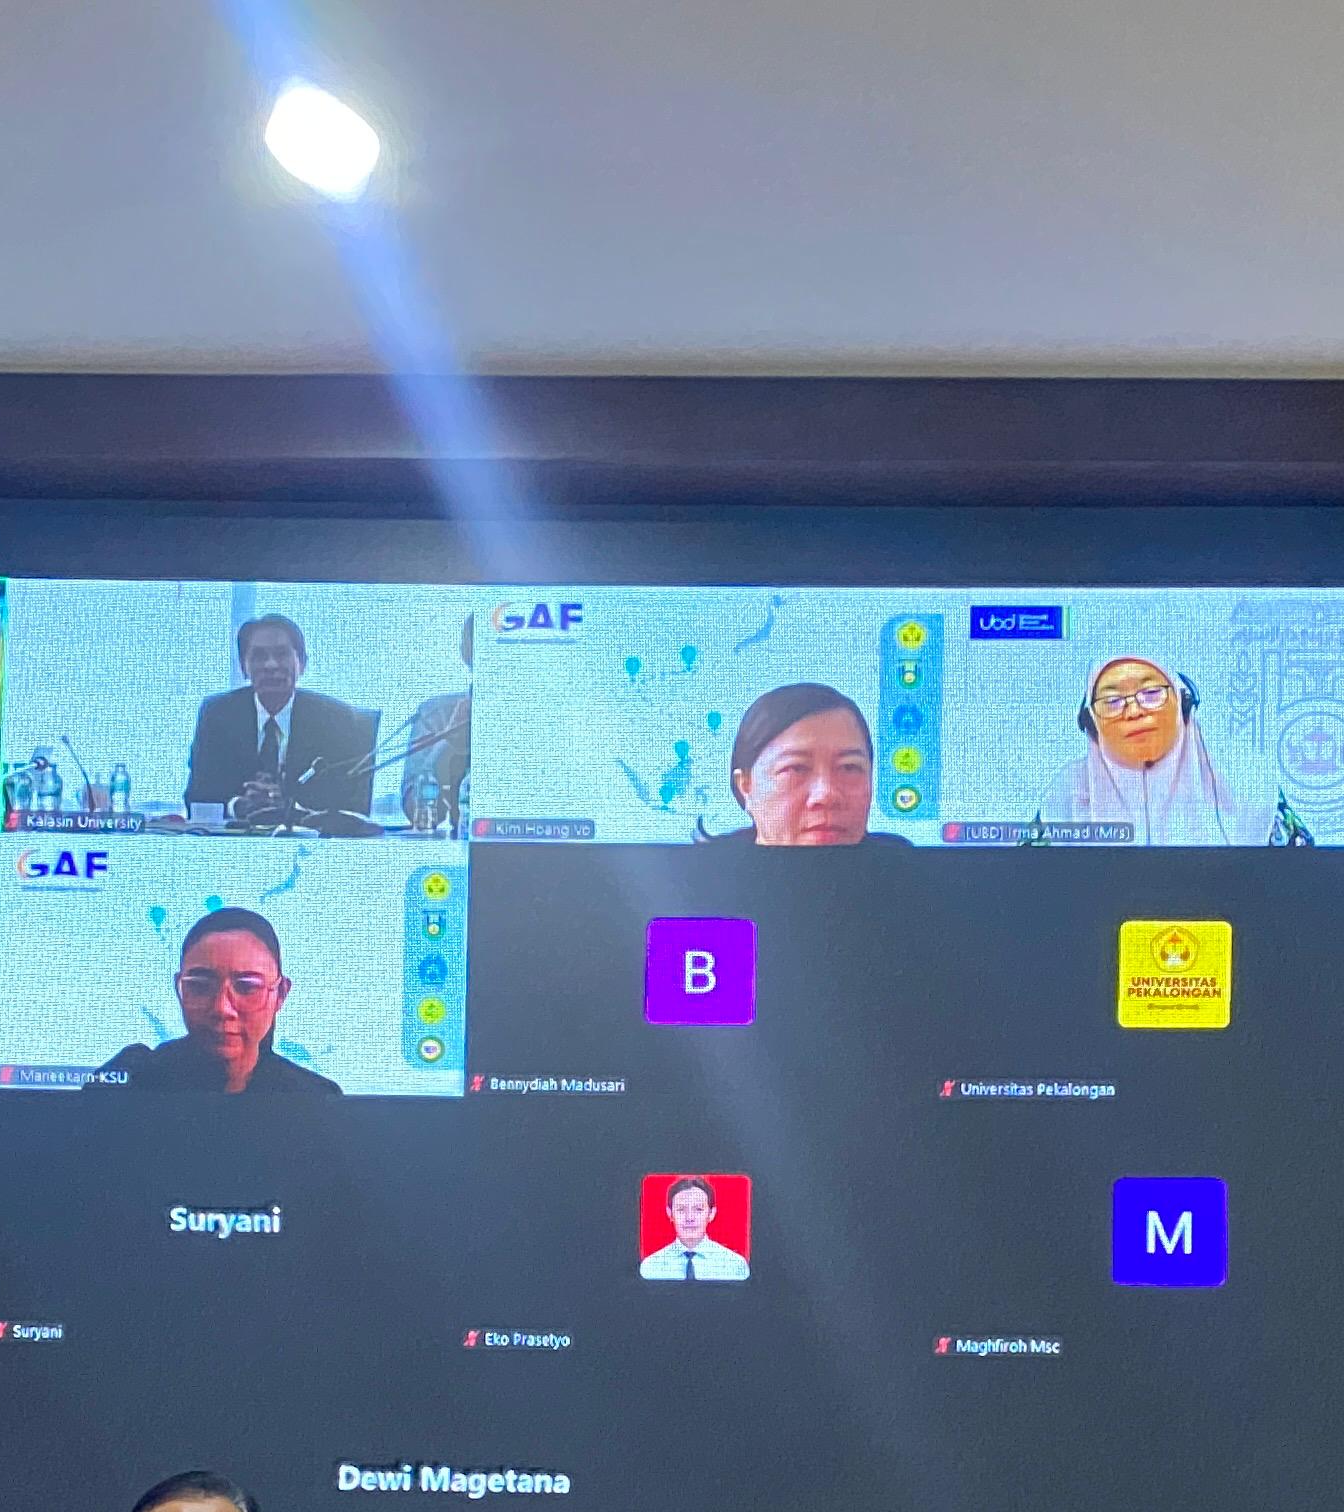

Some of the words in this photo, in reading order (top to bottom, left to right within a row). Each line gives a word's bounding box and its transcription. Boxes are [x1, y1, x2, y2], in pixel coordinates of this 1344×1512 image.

[26, 814, 73, 828] Kalasin
[77, 815, 142, 831] University
[494, 823, 521, 835] Kim
[1042, 826, 1089, 840] Ahmad
[1094, 826, 1130, 841] (Mrs)
[17, 849, 109, 880] GAF
[684, 950, 717, 995] B
[1131, 976, 1217, 987] UNIVERSITAS
[1127, 987, 1222, 998] PEKALONGAN
[490, 1078, 557, 1094] Bennydiah
[561, 1078, 626, 1092] Madusari
[960, 1082, 1034, 1096] Universitas
[1037, 1082, 1116, 1100] Pekalongan
[169, 1205, 281, 1239] Suryani
[1146, 1210, 1193, 1255] M
[12, 1324, 63, 1341] Suryani
[484, 1332, 510, 1346] Eko
[513, 1332, 571, 1350] Prasetyo
[956, 1338, 1027, 1357] Maghfiroh
[1030, 1340, 1060, 1354] Msc
[337, 1464, 412, 1492] Dewi
[420, 1465, 571, 1499] Magetana
